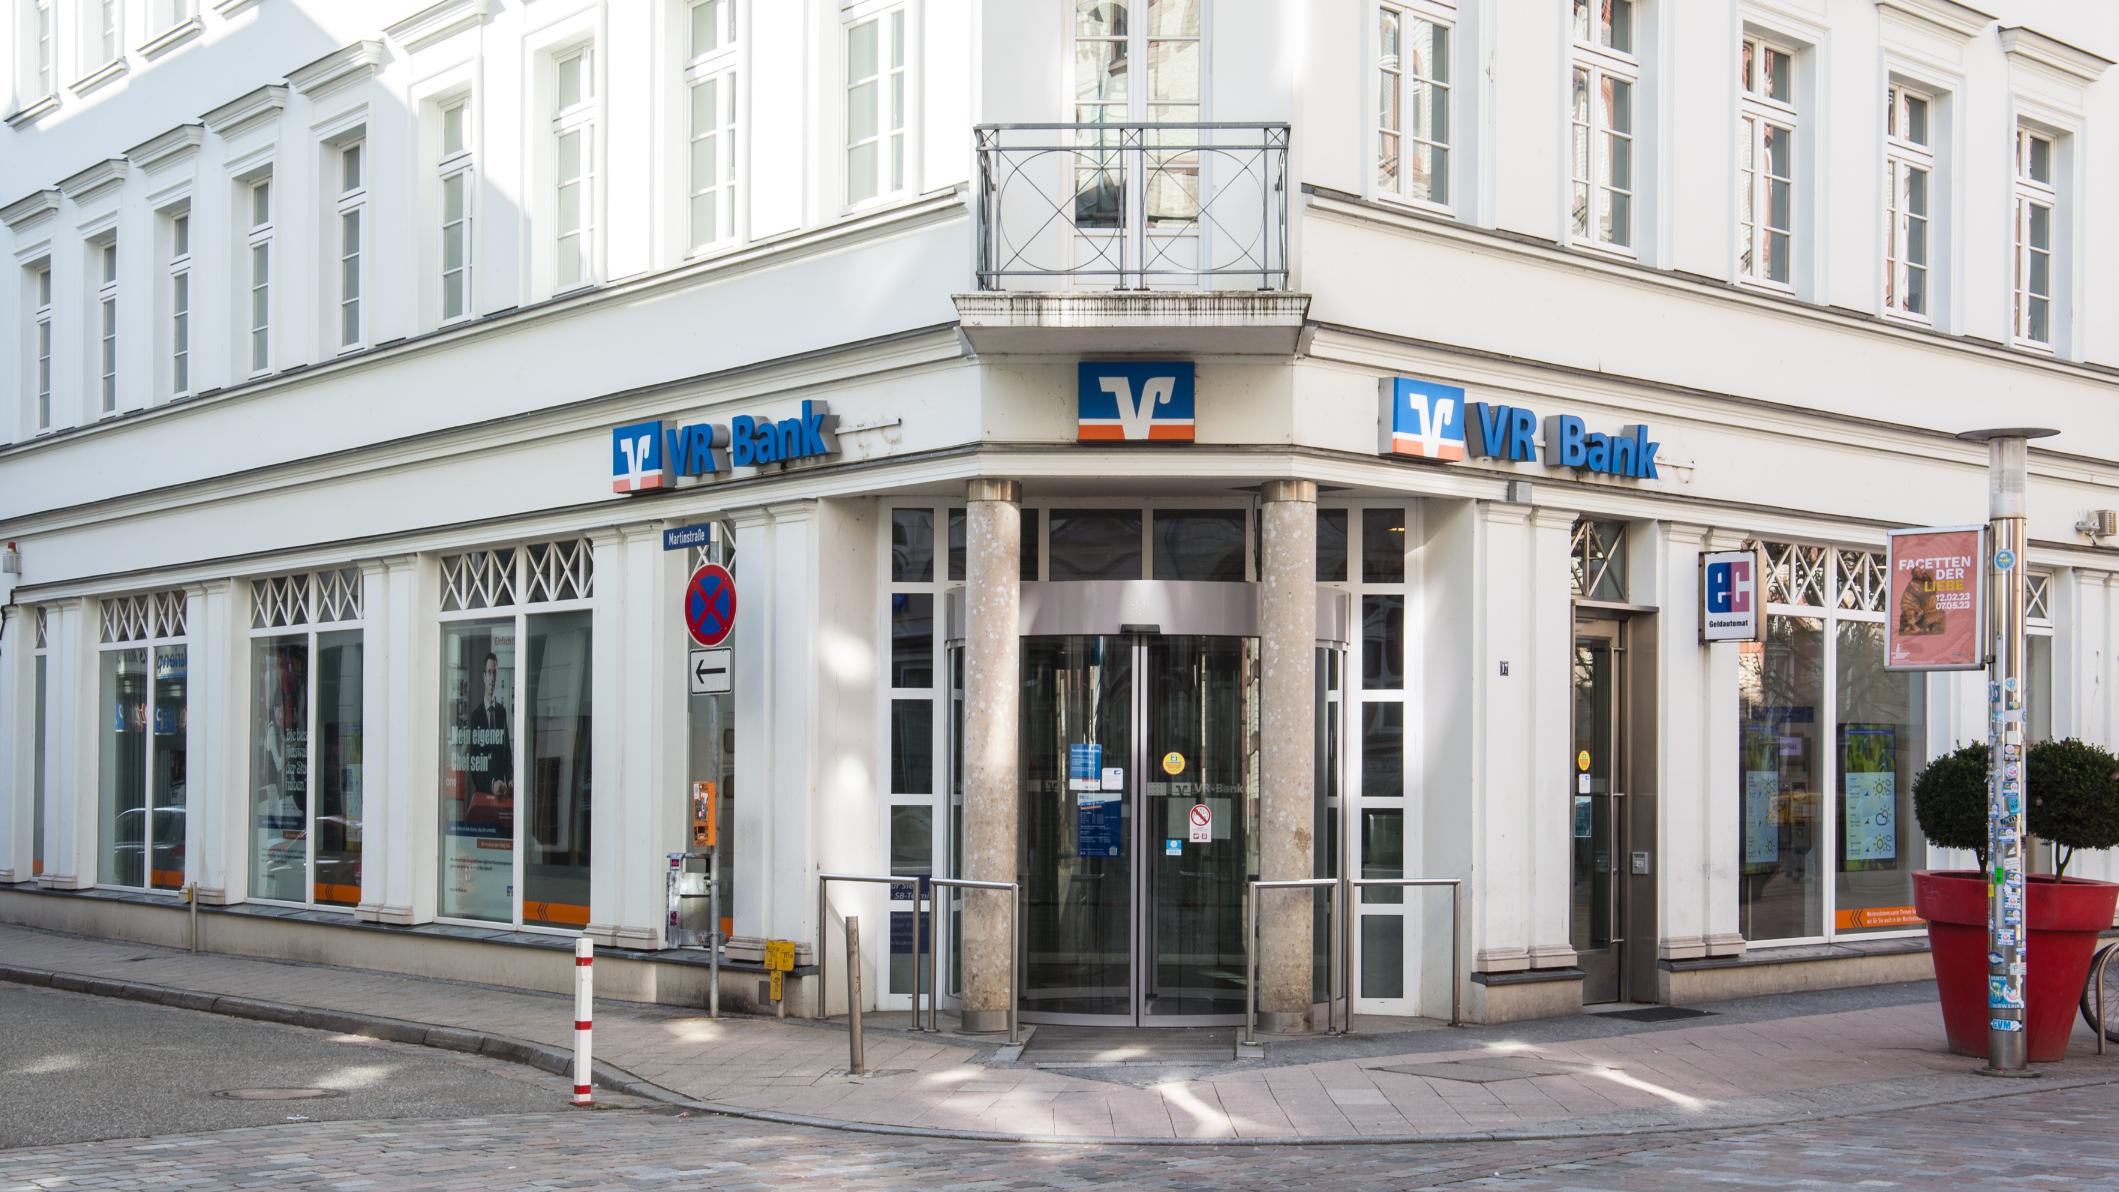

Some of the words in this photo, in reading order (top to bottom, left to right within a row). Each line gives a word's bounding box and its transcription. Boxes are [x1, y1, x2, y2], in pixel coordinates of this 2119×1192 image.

[666, 423, 722, 477] VR
[732, 400, 832, 467] Bank
[1472, 401, 1537, 462] VR
[1555, 414, 1661, 479] Bank
[668, 528, 705, 546] Martinstraße
[1898, 555, 1971, 571] FACETTEN
[1935, 568, 1964, 580] DER
[1924, 579, 1964, 592] LIEBE
[1709, 619, 1748, 628] Geldautomat
[472, 726, 505, 748] eigener
